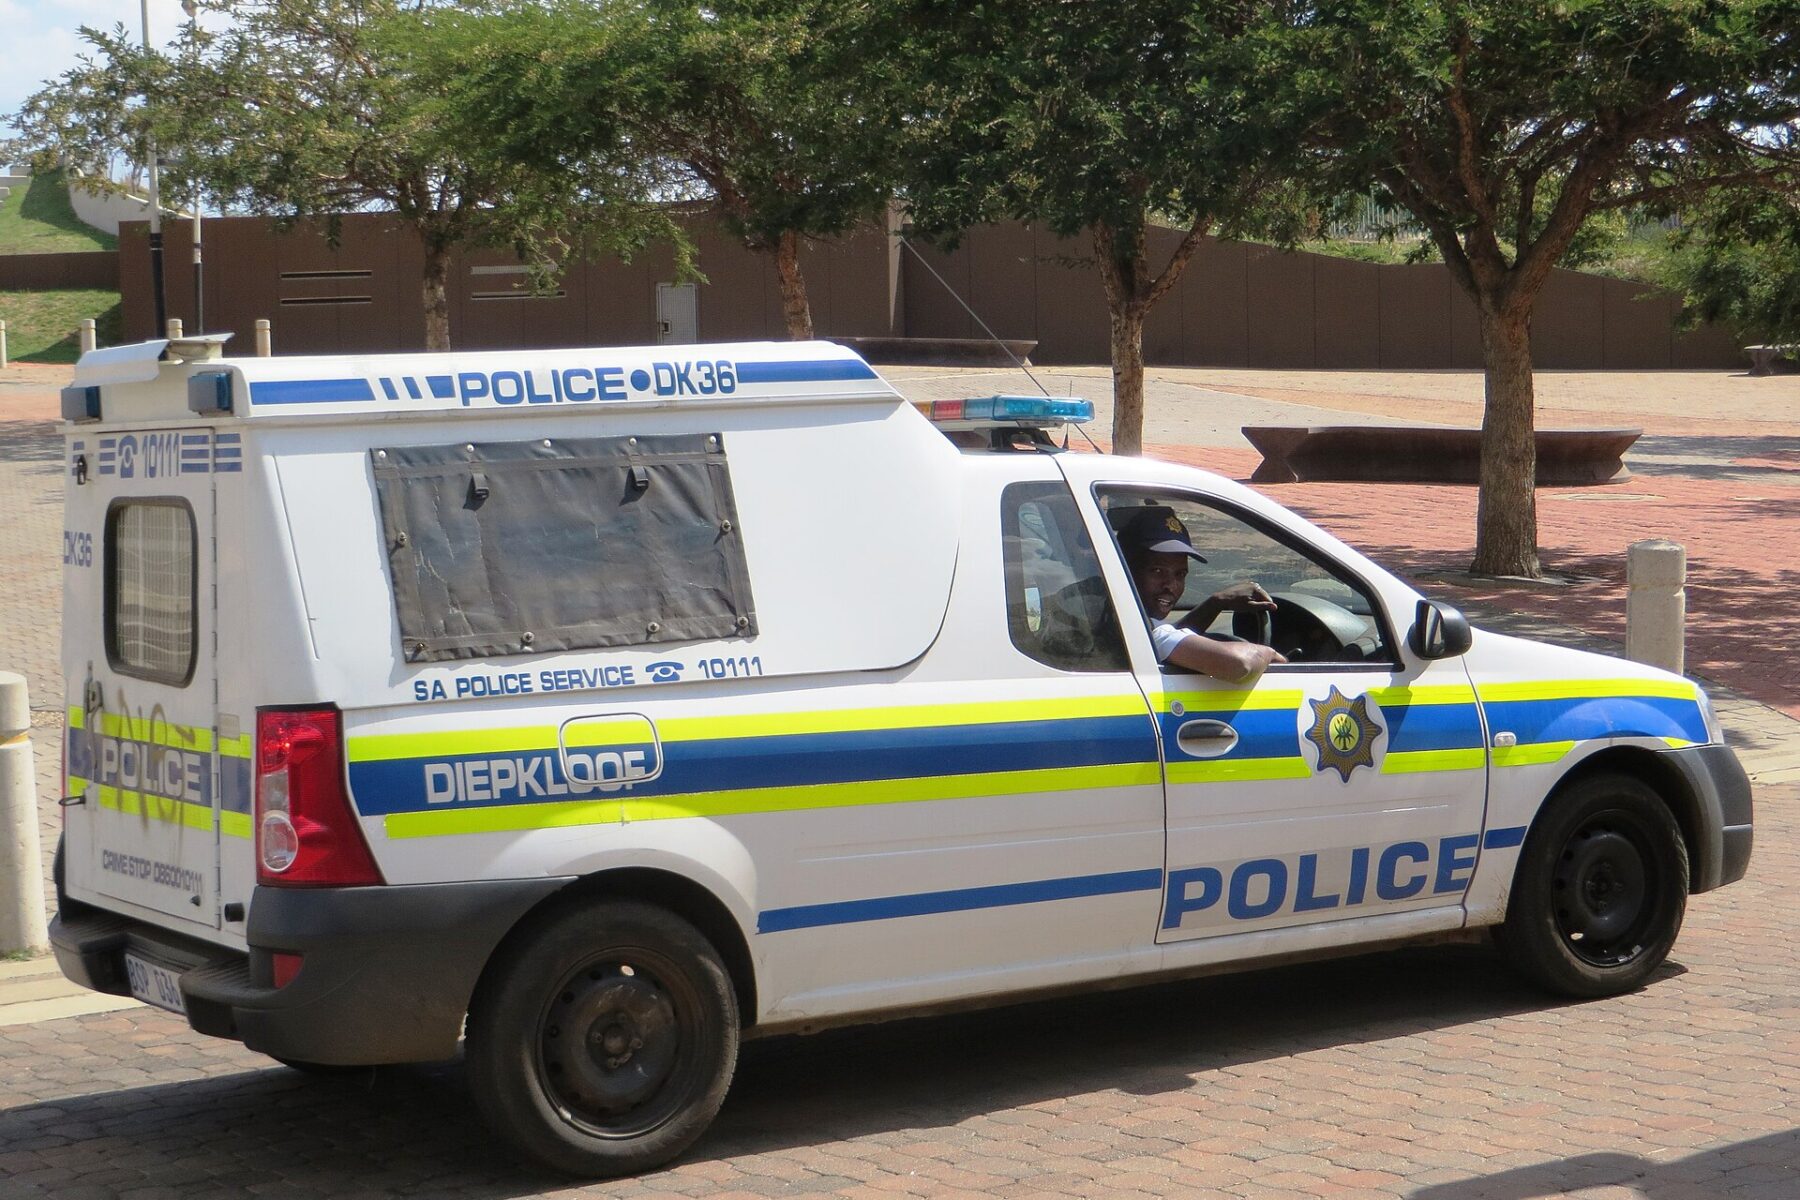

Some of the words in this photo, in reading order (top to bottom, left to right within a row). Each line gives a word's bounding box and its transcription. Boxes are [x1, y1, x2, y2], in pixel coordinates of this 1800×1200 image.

[458, 367, 628, 407] POLICE
[652, 359, 736, 397] DK36
[142, 432, 180, 479] 10111
[414, 679, 448, 701] SA
[456, 672, 534, 698] POLICE
[540, 665, 635, 692] SERVICE
[698, 656, 764, 680] 10111
[101, 737, 202, 801] POLICE
[423, 750, 647, 804] DIEPKLOOF
[1162, 833, 1480, 930] POLICE
